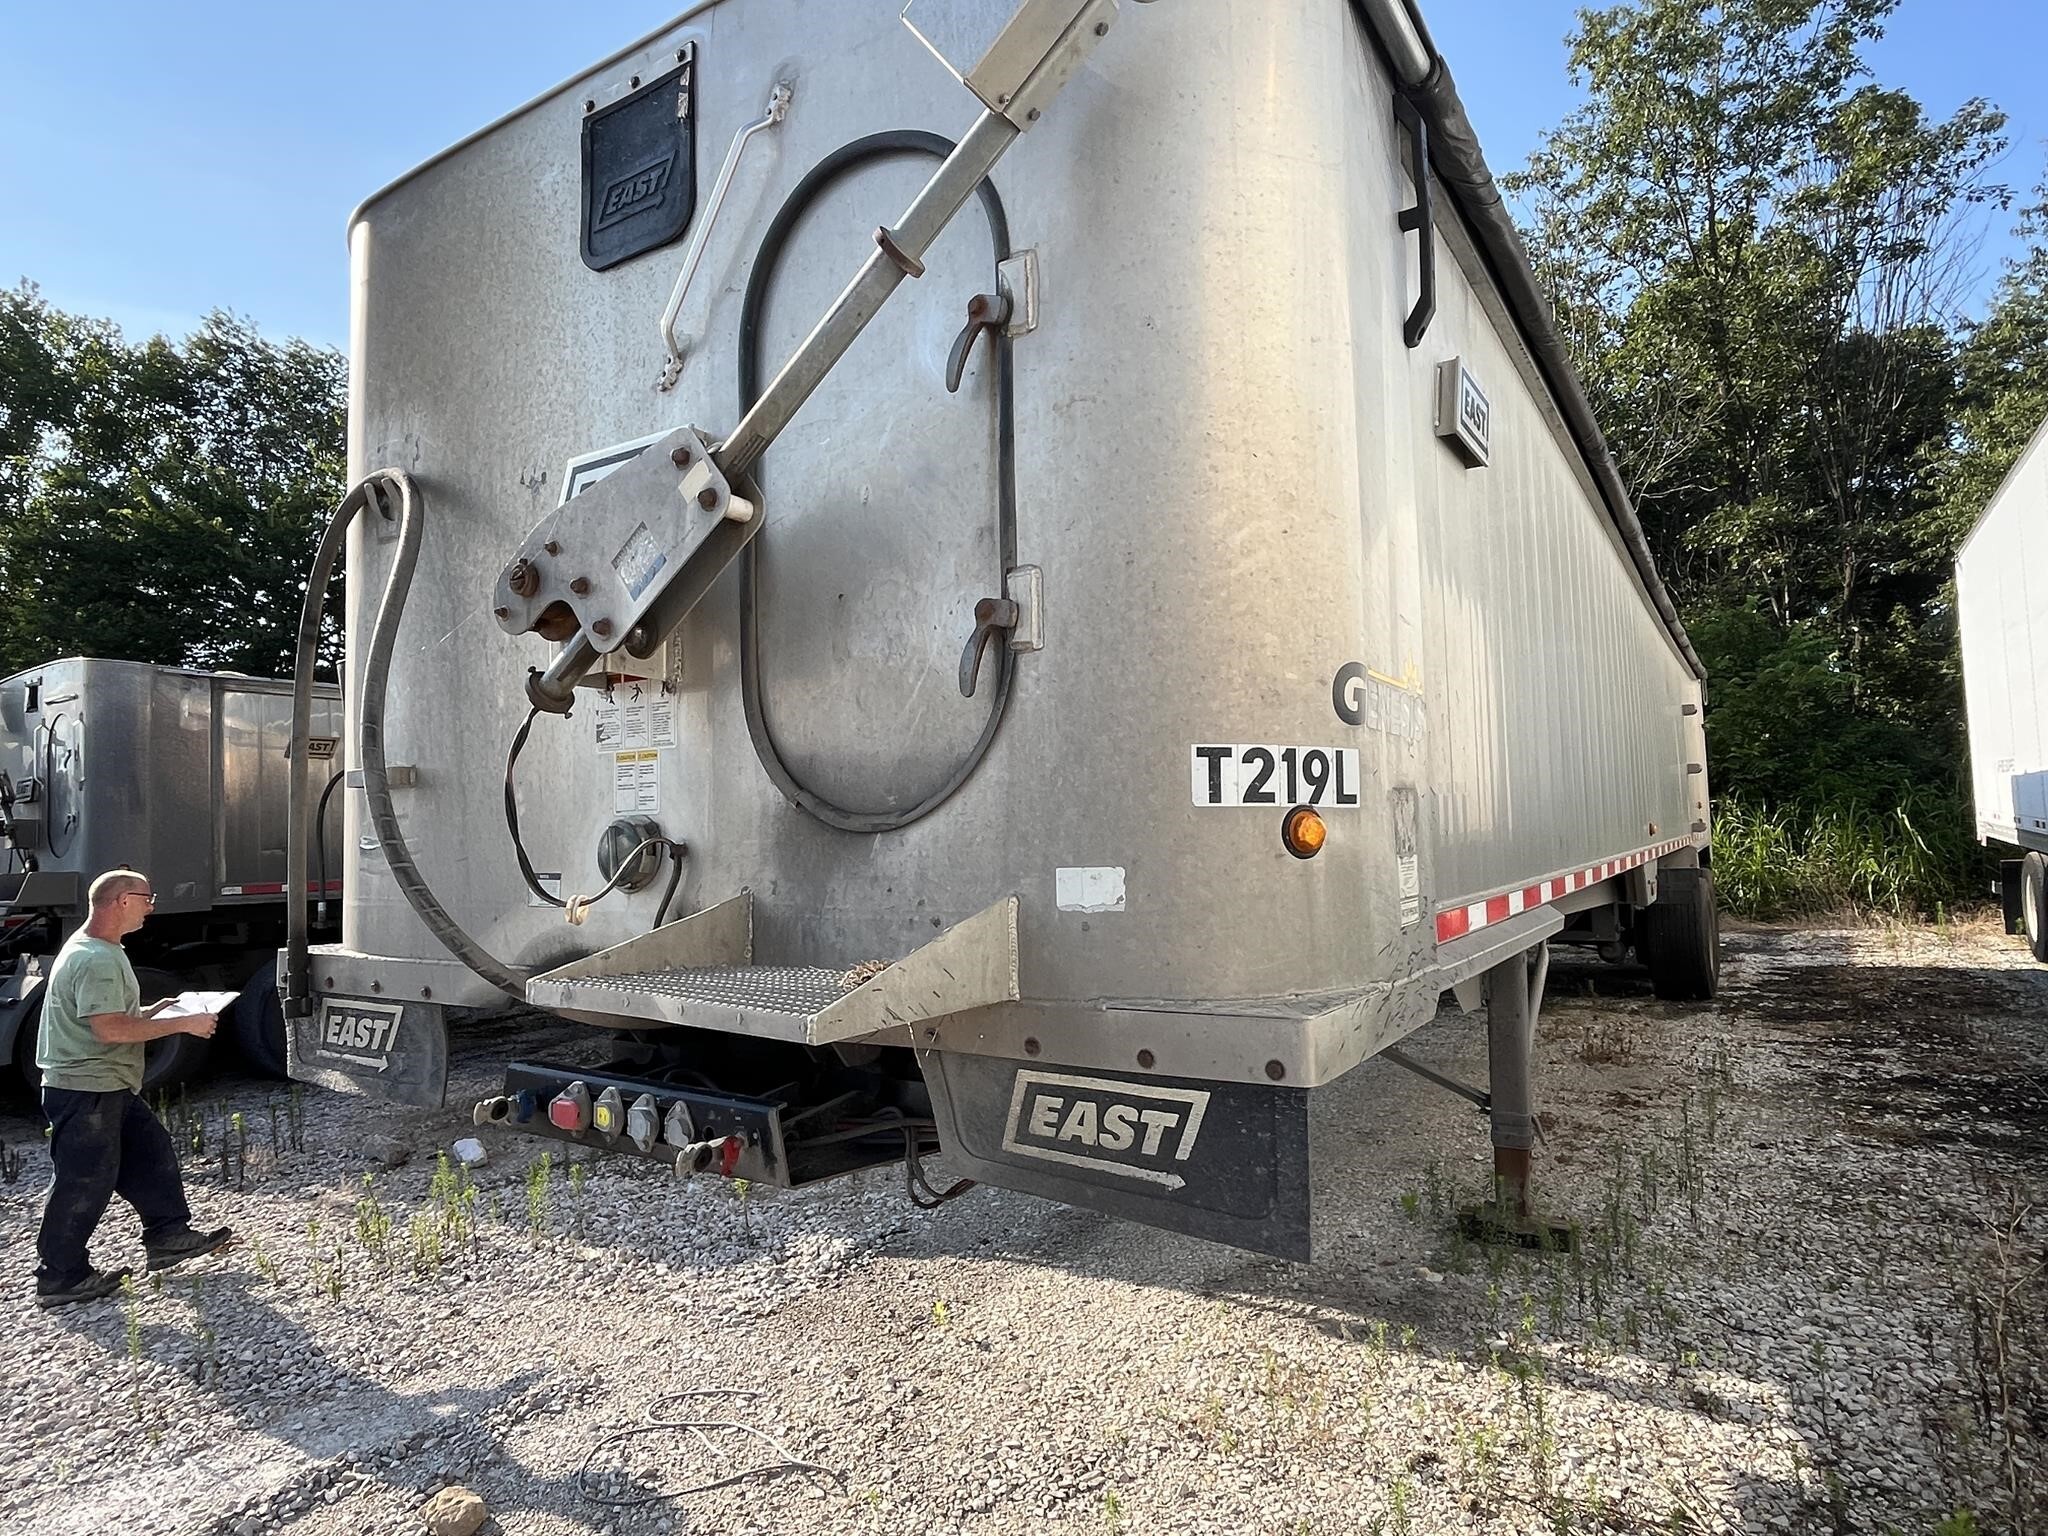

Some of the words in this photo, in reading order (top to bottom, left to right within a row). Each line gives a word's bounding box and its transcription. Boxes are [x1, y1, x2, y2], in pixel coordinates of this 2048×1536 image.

[606, 169, 664, 215] EAST
[1464, 387, 1487, 437] EAST
[308, 742, 330, 752] AST
[1197, 747, 1357, 804] T219L
[327, 1015, 389, 1050] EAST
[1028, 1094, 1180, 1156] EAST
